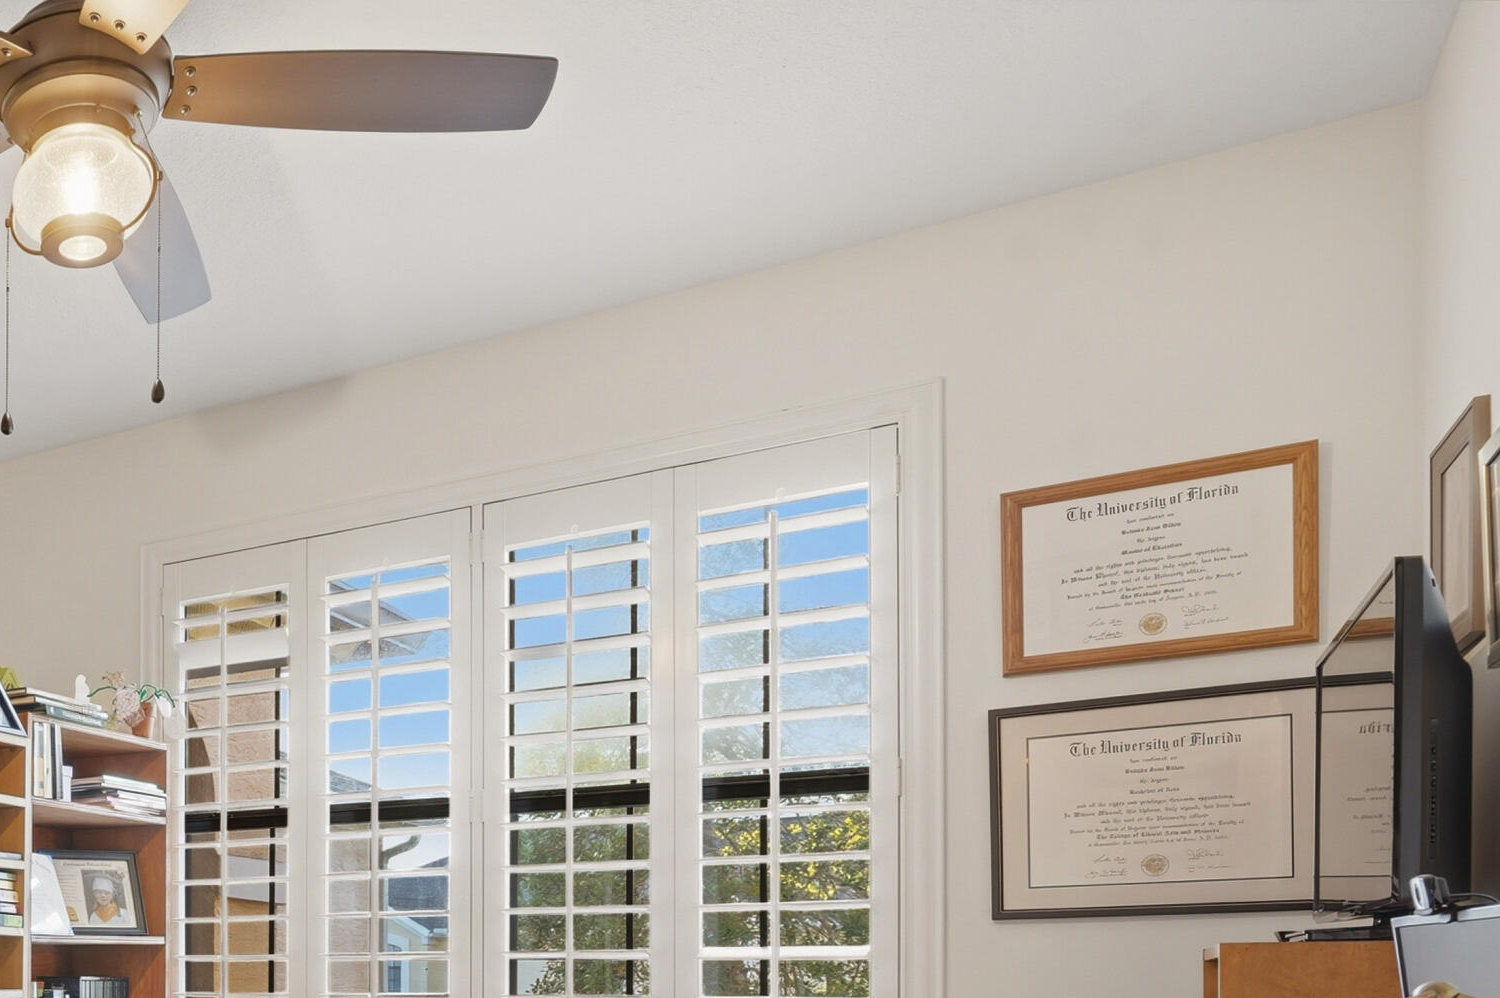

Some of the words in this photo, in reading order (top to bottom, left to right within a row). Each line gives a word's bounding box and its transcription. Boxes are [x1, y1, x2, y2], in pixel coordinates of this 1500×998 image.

[1066, 506, 1092, 522] The
[1097, 497, 1167, 517] University
[1170, 492, 1184, 505] of
[1186, 485, 1239, 502] Florida
[1069, 742, 1097, 758] The
[1100, 738, 1169, 754] University
[1172, 735, 1186, 747] of
[1188, 731, 1242, 747] Florida
